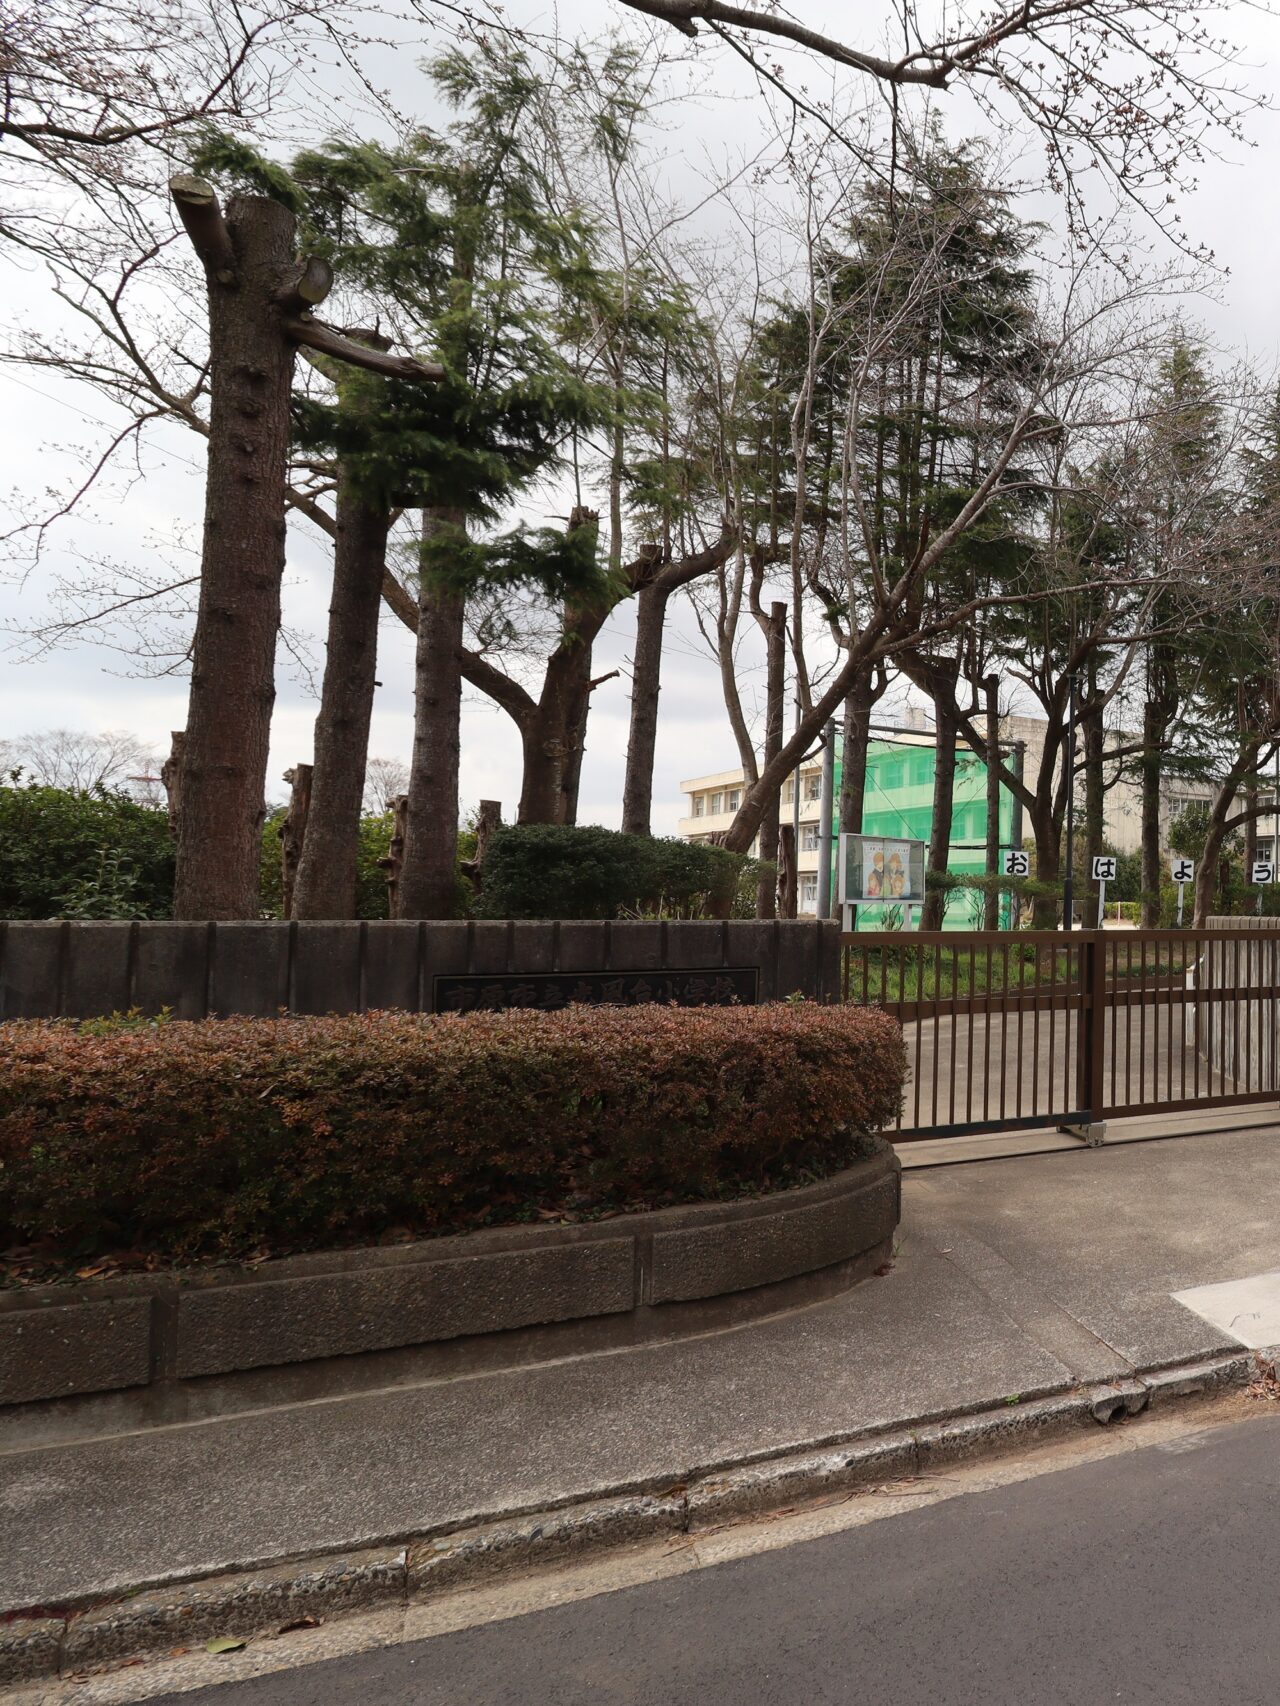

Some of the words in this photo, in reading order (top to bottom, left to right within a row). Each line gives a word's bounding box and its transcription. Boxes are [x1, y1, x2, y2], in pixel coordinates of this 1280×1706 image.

[1006, 852, 1027, 874] お
[1094, 858, 1114, 878] は
[1174, 860, 1192, 880] よ
[1254, 863, 1272, 882] う
